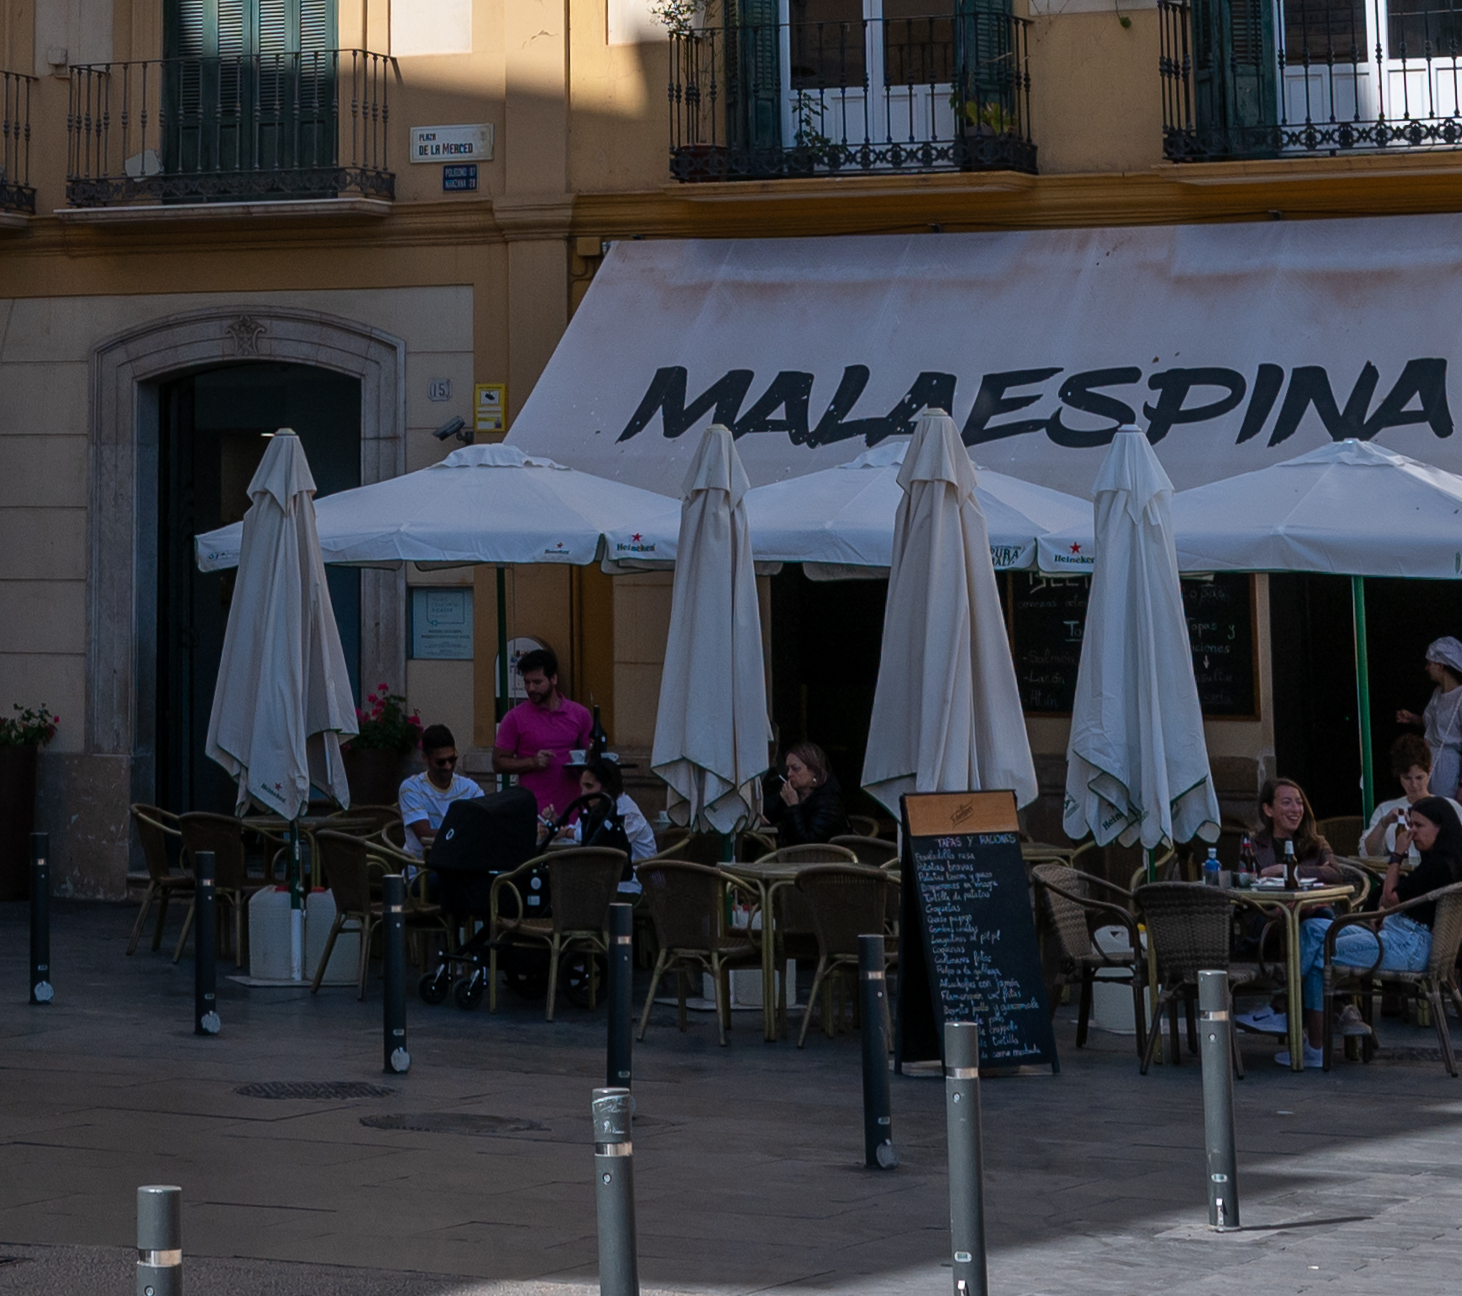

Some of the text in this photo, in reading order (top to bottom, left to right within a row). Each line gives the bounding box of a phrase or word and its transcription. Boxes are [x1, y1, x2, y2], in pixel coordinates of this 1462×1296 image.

[419, 133, 436, 141] PLAZA
[419, 145, 429, 156] DE
[430, 144, 440, 155] LA
[433, 383, 446, 396] 15
[616, 542, 656, 552] Heineken
[261, 782, 287, 804] Heineken
[1101, 811, 1125, 832] Hein
[935, 833, 1016, 848] TAPAS Y RACIONES
